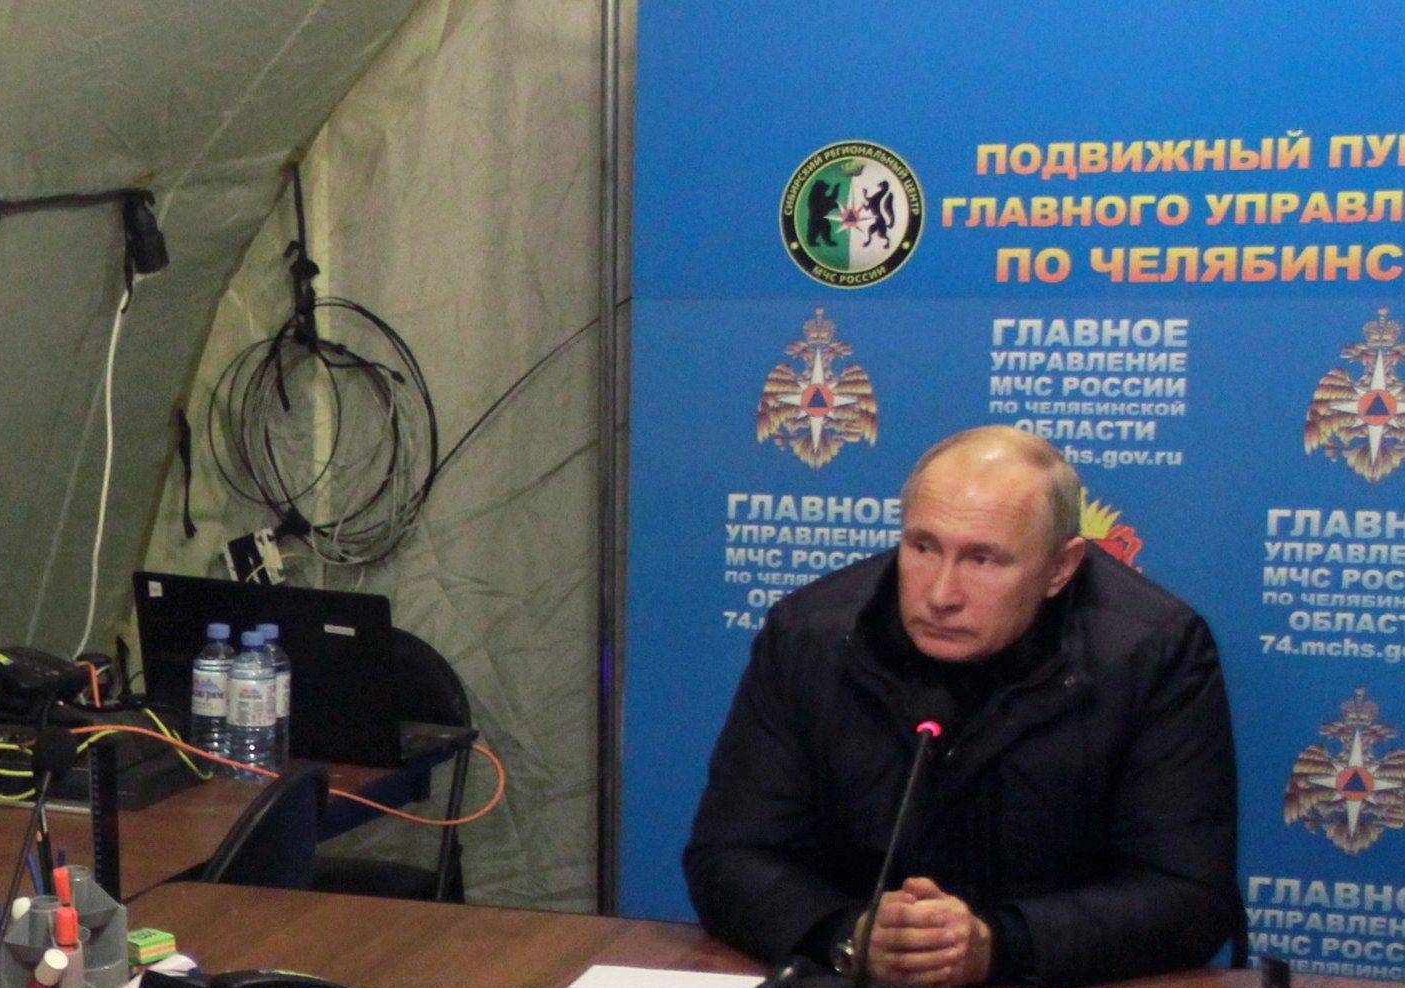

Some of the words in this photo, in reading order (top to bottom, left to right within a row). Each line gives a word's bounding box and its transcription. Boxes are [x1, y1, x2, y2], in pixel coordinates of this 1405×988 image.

[976, 129, 1311, 180] ПОДВИЖНЫЙ
[825, 145, 907, 179] РЕГИОНАЛЬНЫЙ
[903, 177, 920, 216] ЦЕНТР
[941, 194, 1190, 228] ГЛАВНОГО
[811, 265, 839, 282] МЧС
[839, 265, 887, 284] РОССИИ
[996, 247, 1071, 283] ПО
[1090, 243, 1404, 283] ЧЕЛЯБИНС
[992, 318, 1189, 348] ГЛАВНОЕ
[990, 351, 1187, 373] УПРАВЛЕНИЕ
[990, 375, 1053, 397] МЧС
[1062, 376, 1187, 398] РОССИИ
[989, 400, 1019, 415] ПО
[1025, 400, 1187, 416] ЧЕЛЯБИНСКОЙ
[727, 493, 902, 525] ГЛАВНОЕ
[725, 547, 783, 568] МЧС
[724, 570, 752, 584] ПО
[1263, 566, 1332, 589] МЧС
[1341, 568, 1405, 590] РОС
[1262, 591, 1294, 606] ПО
[1259, 635, 1405, 663] 74.mchs.g
[1321, 937, 1405, 962] РОСС
